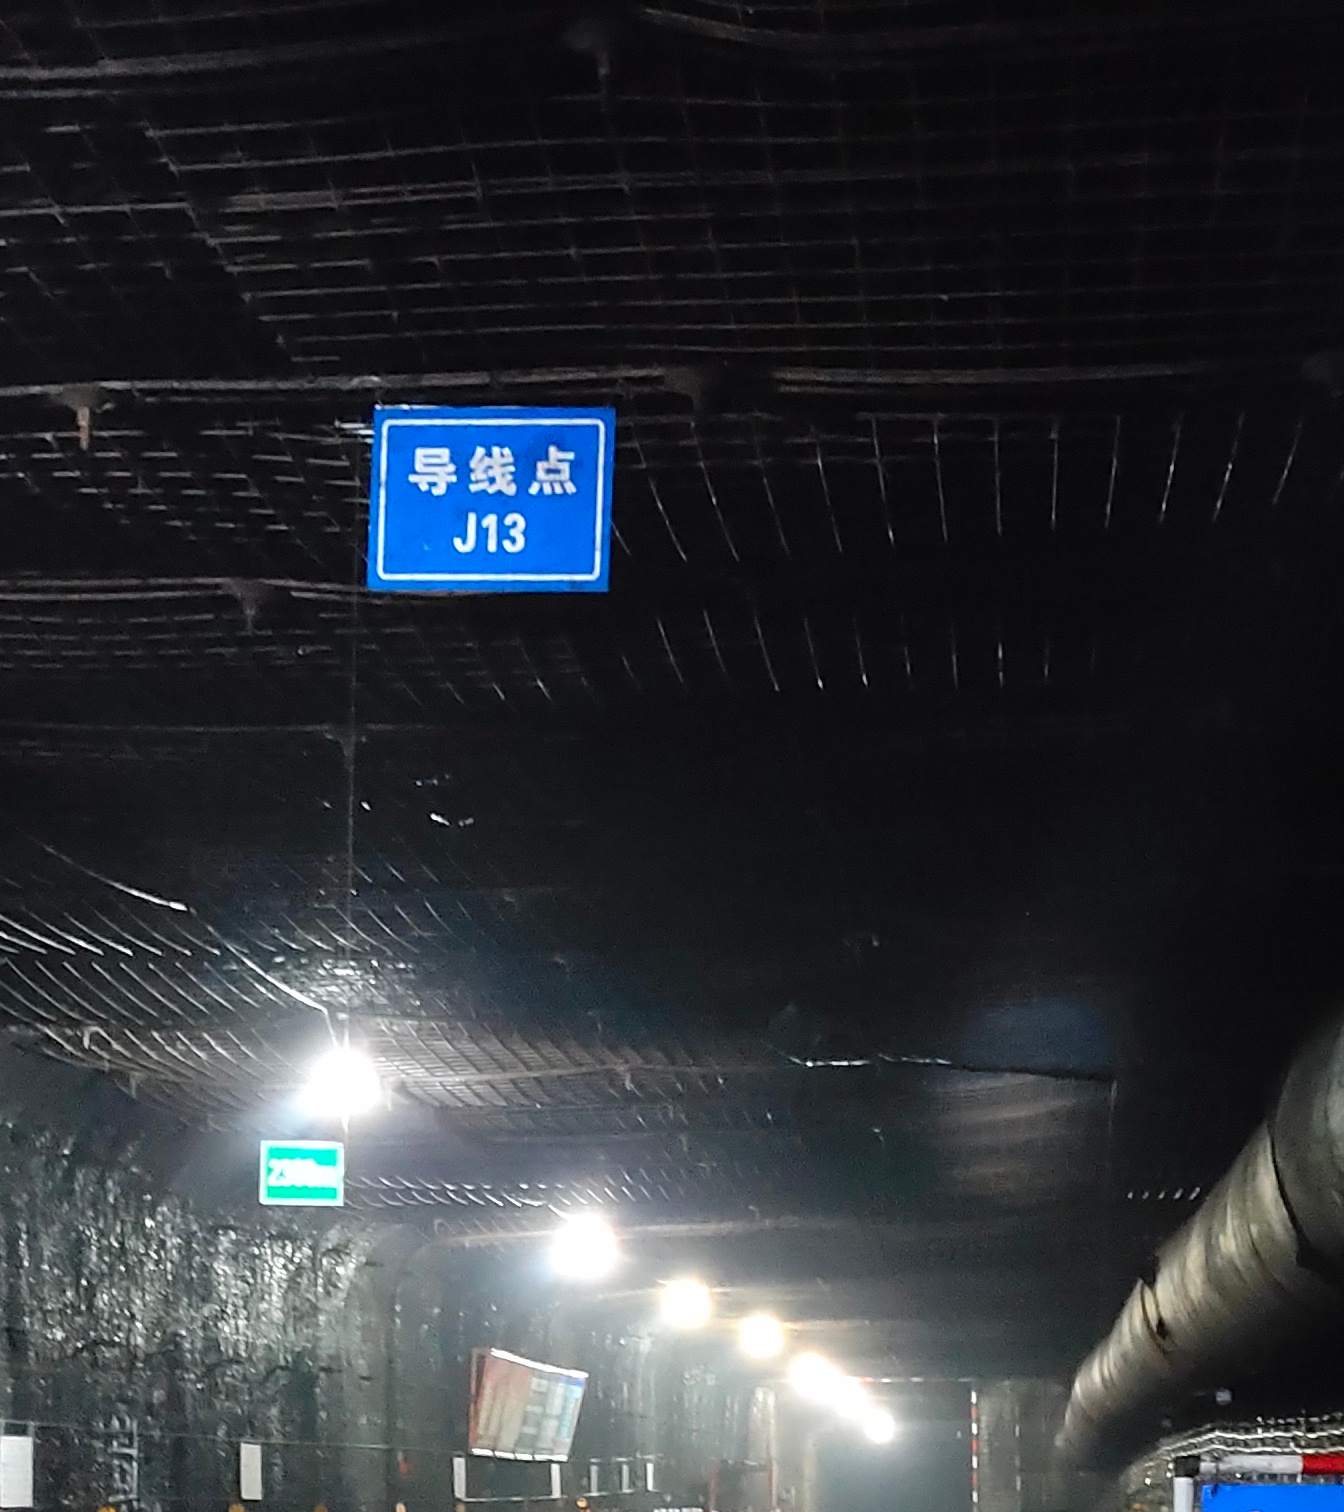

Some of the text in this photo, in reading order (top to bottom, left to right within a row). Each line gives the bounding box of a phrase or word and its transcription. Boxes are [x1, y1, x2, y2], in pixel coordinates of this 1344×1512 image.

[408, 445, 577, 496] 导线点
[453, 512, 527, 553] J13
